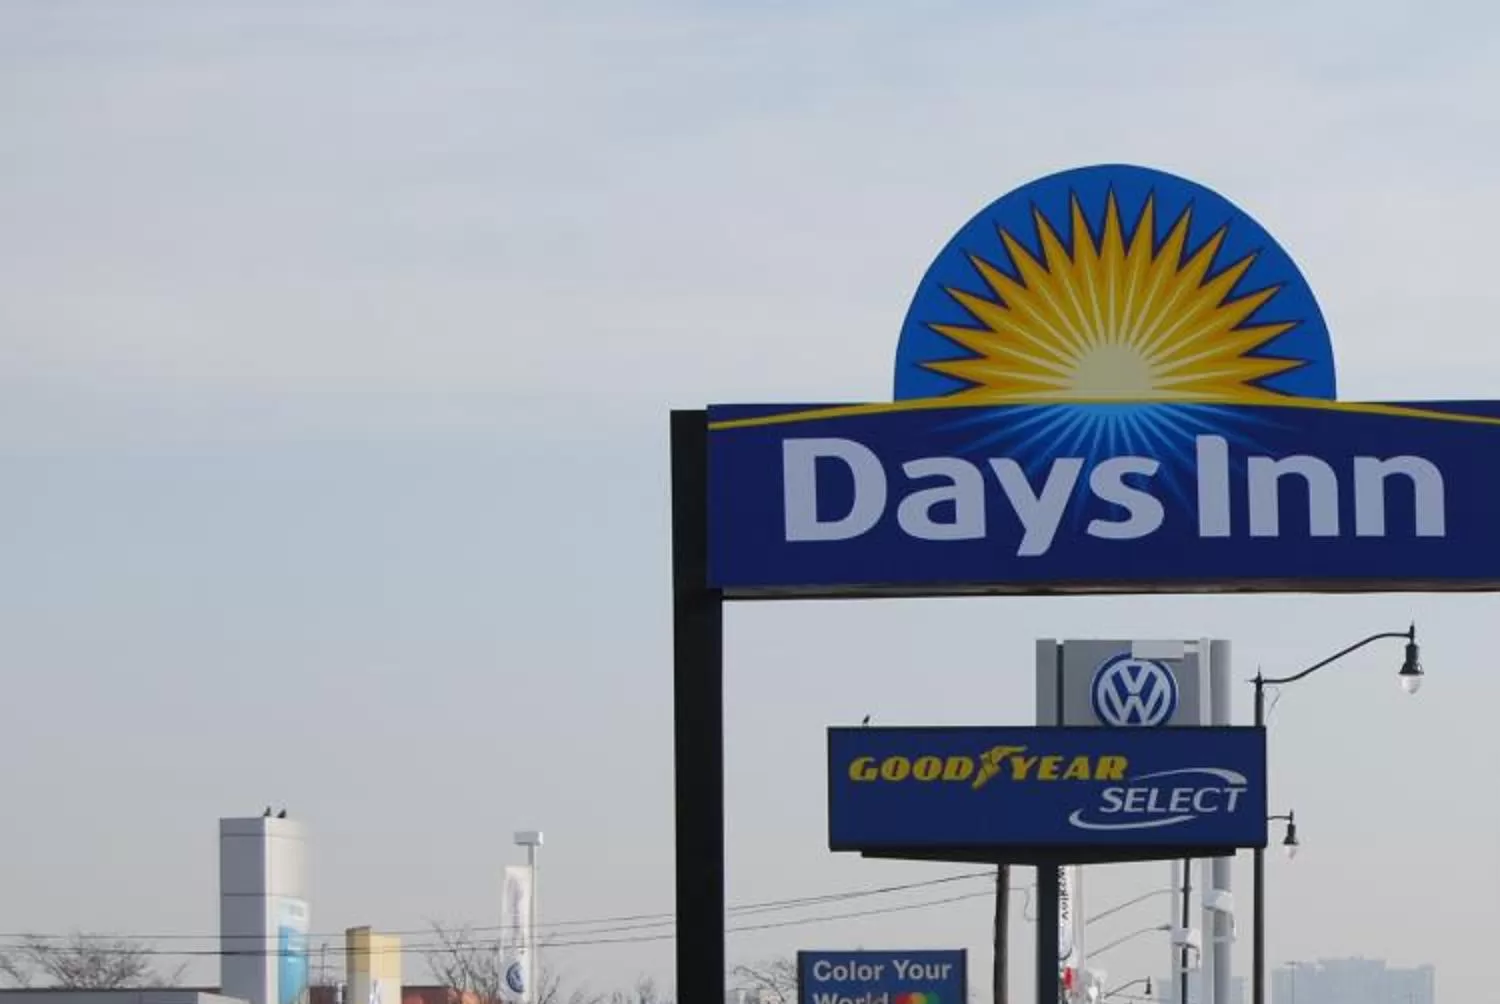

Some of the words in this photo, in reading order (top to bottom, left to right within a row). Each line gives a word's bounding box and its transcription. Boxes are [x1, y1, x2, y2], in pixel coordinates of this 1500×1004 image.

[782, 437, 1164, 557] Days
[1196, 435, 1446, 539] Inn
[849, 755, 1128, 781] GOODYEAR
[1100, 787, 1247, 813] SELECT
[813, 960, 885, 981] Color
[893, 959, 952, 980] Your
